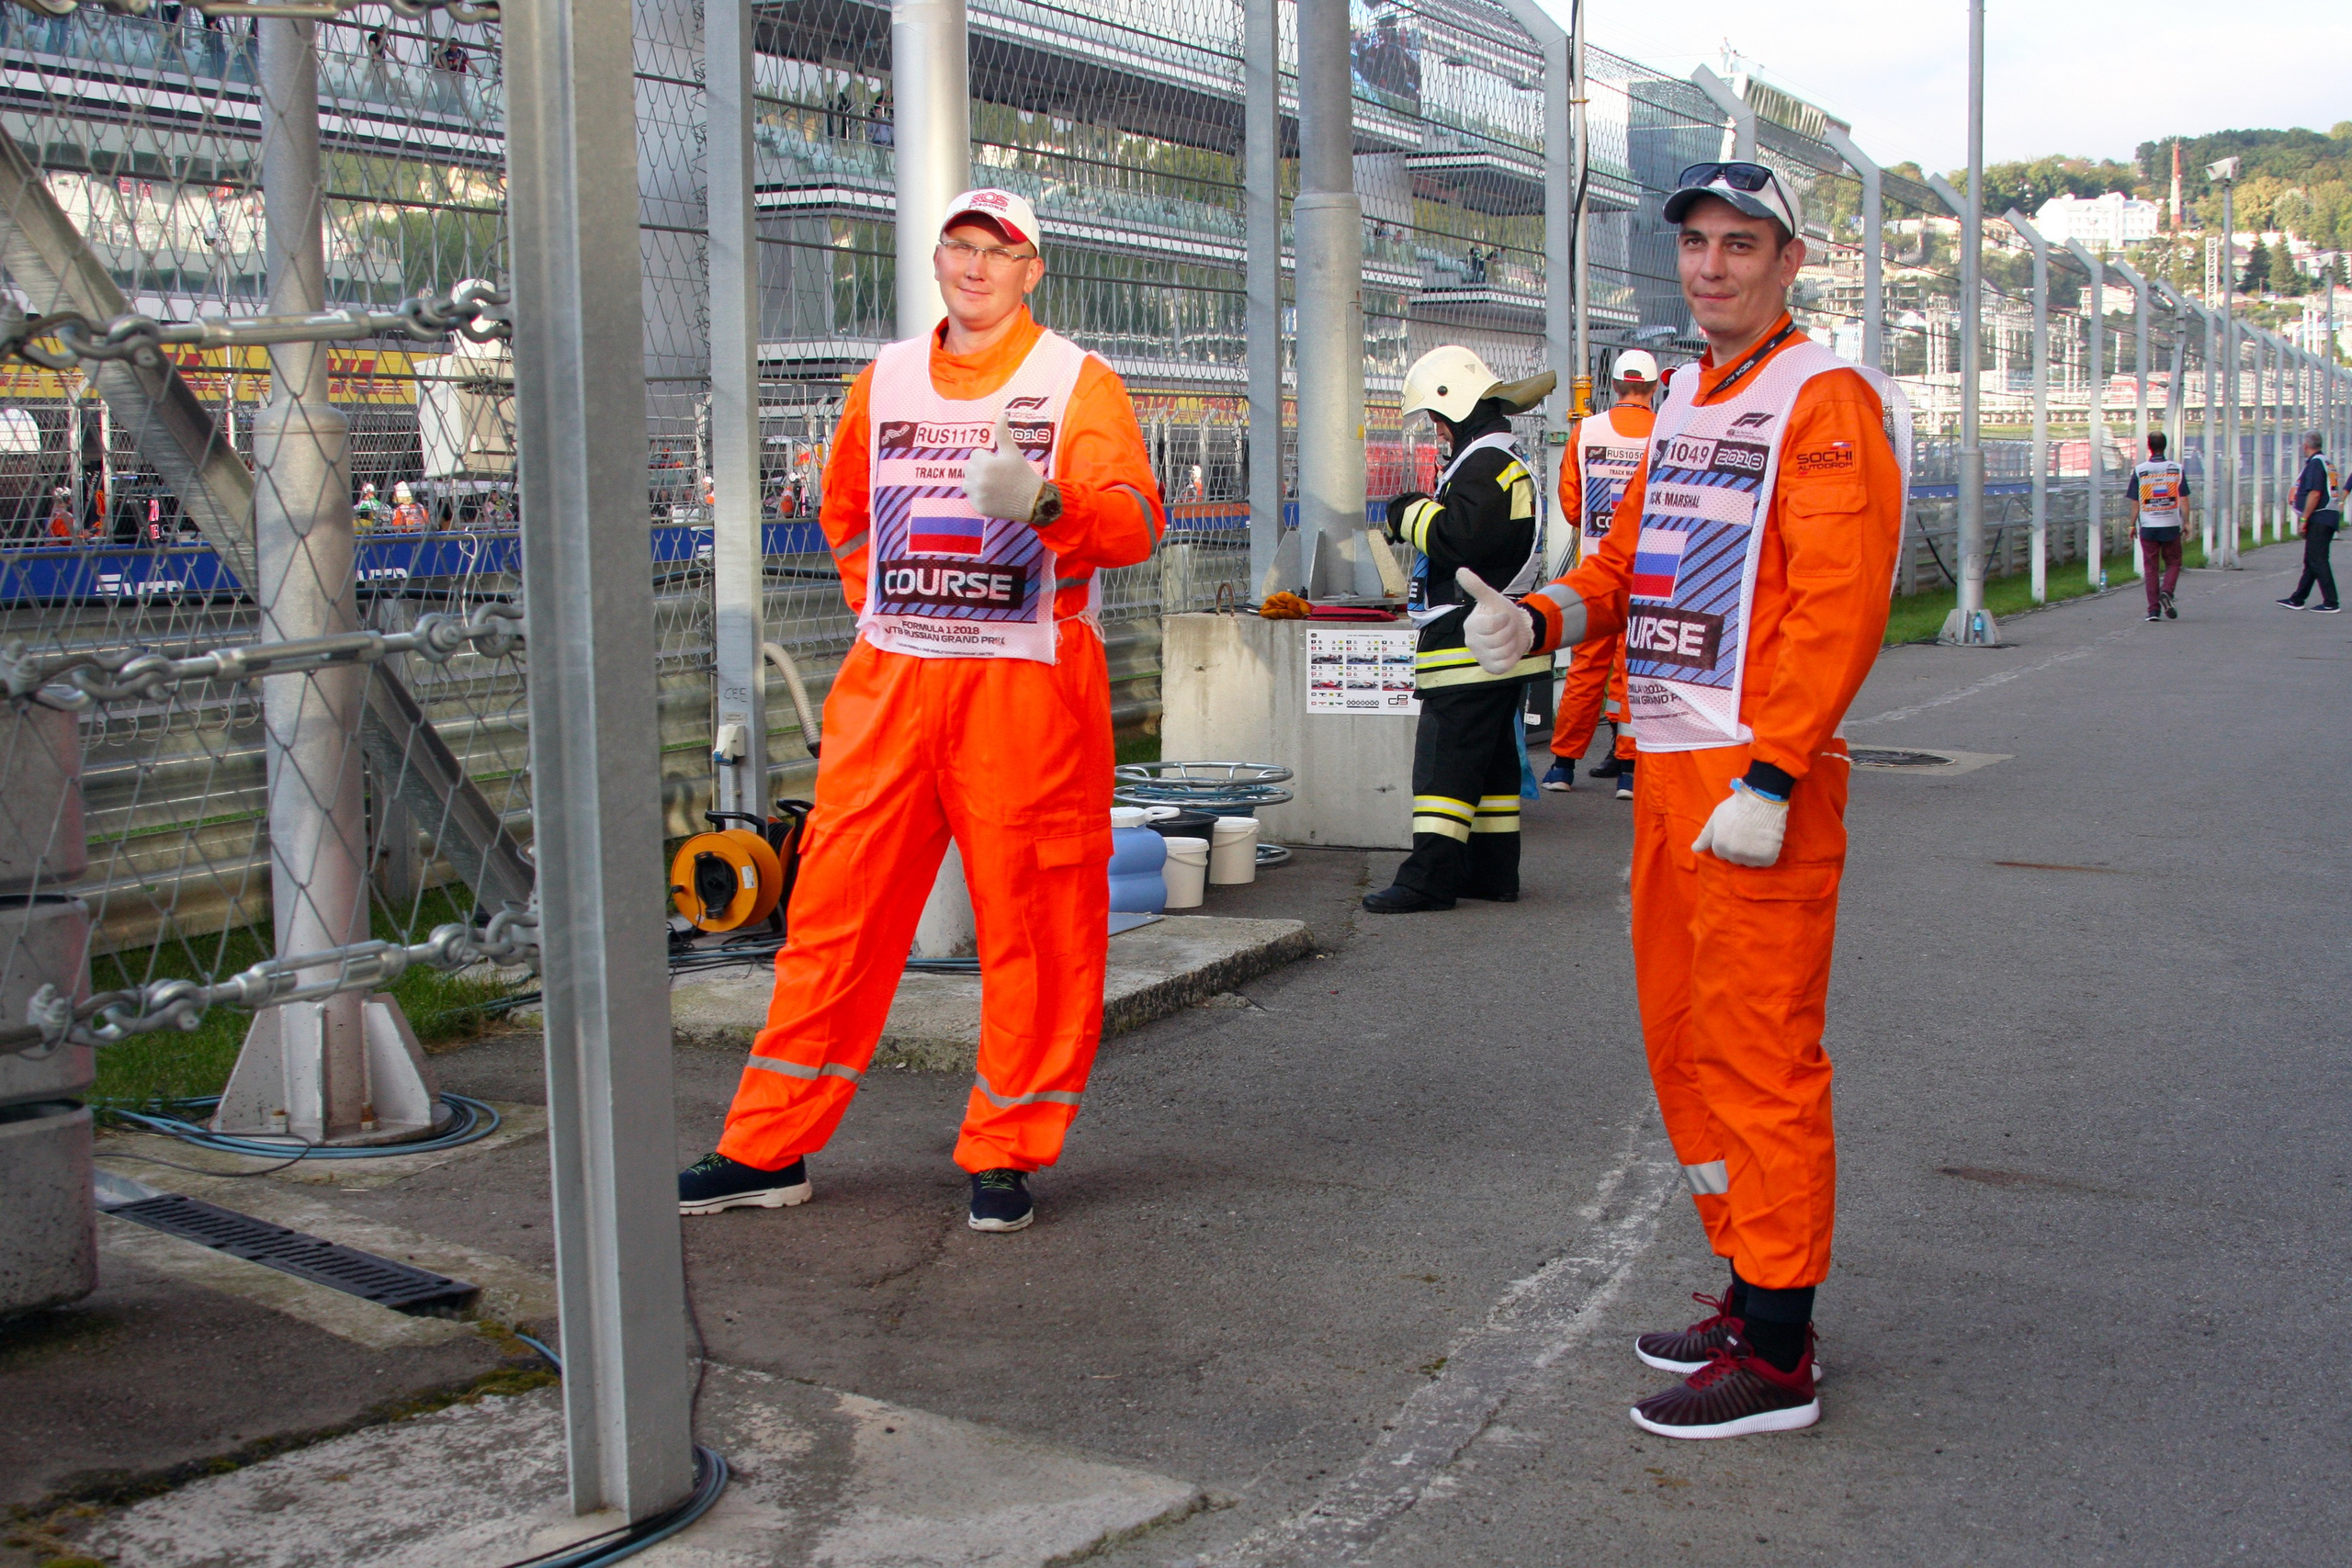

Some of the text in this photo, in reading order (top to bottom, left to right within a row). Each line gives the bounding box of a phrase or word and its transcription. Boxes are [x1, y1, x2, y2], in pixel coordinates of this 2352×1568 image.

[916, 426, 1051, 445] RUS1179 018
[1714, 448, 1764, 470] 2018
[1796, 450, 1853, 464] SOCHI
[915, 467, 966, 479] TRACK MA
[1797, 461, 1853, 471] AUTODROM
[1664, 492, 1701, 509] MARSHAL
[885, 568, 1013, 601] COURSE
[885, 626, 904, 634] VTB
[904, 628, 940, 642] RUSSIAN
[941, 634, 979, 644] GRAND
[901, 620, 980, 635] FORMULA 1 2018
